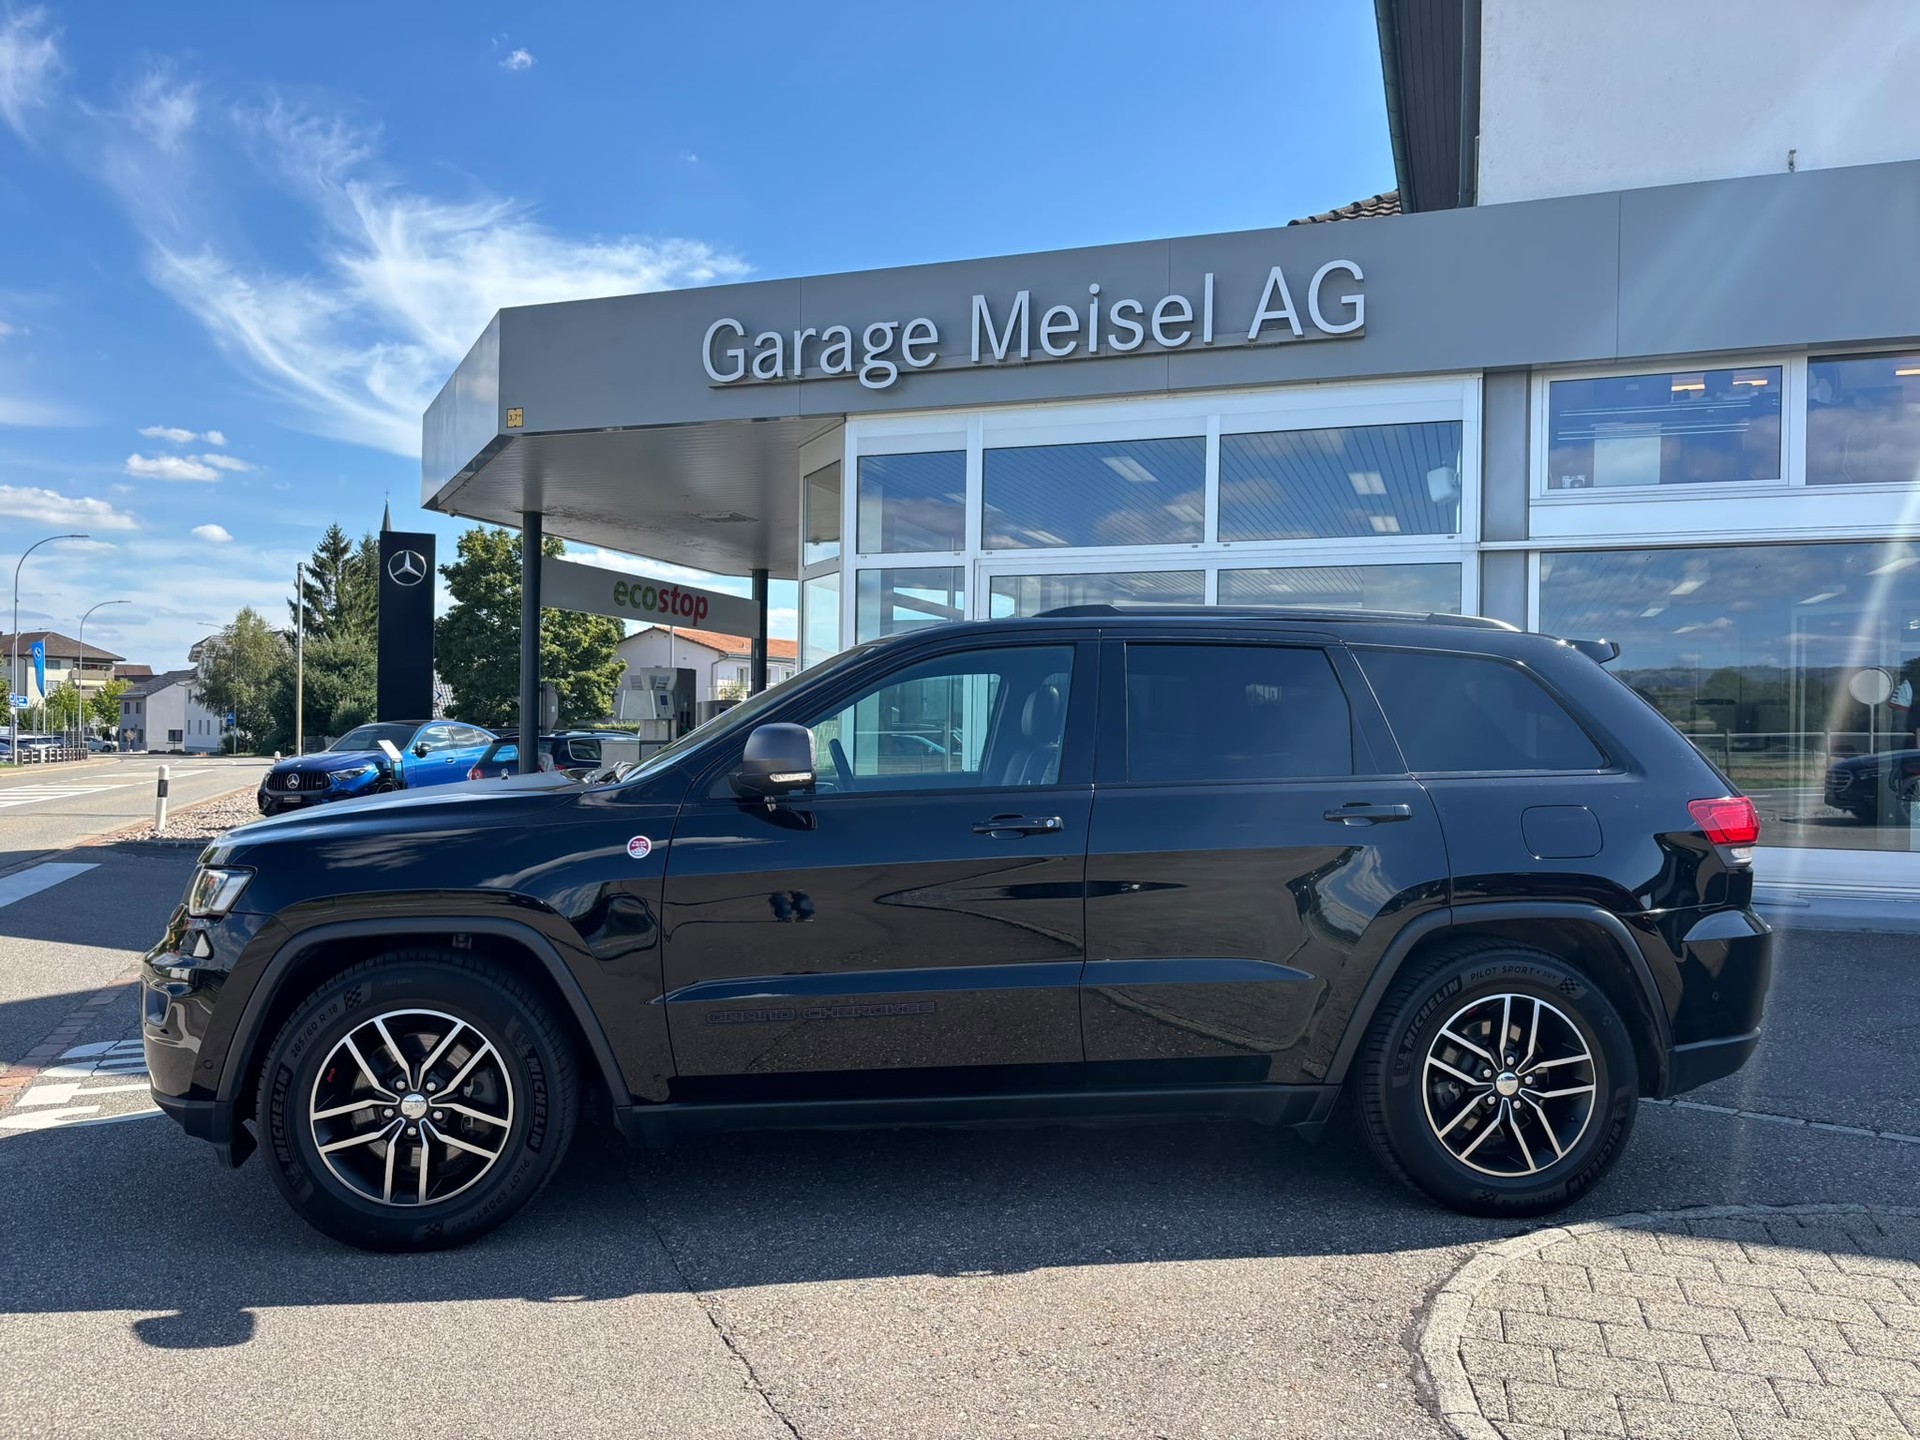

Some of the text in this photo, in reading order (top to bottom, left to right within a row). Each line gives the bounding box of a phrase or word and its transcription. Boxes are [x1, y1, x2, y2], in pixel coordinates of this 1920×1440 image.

[702, 259, 1365, 390] Garage Meisel AG
[614, 580, 708, 626] ecostop
[1470, 967, 1497, 982] PILOT
[1502, 965, 1535, 976] SPORT
[706, 1002, 936, 1024] GRAND CHEROKEE
[1406, 973, 1461, 1048] MICHELIN
[291, 1021, 318, 1059] 265/60
[272, 1068, 291, 1162] MICHELIN
[526, 1056, 549, 1151] MICHELIN
[509, 1159, 530, 1190] PILOT
